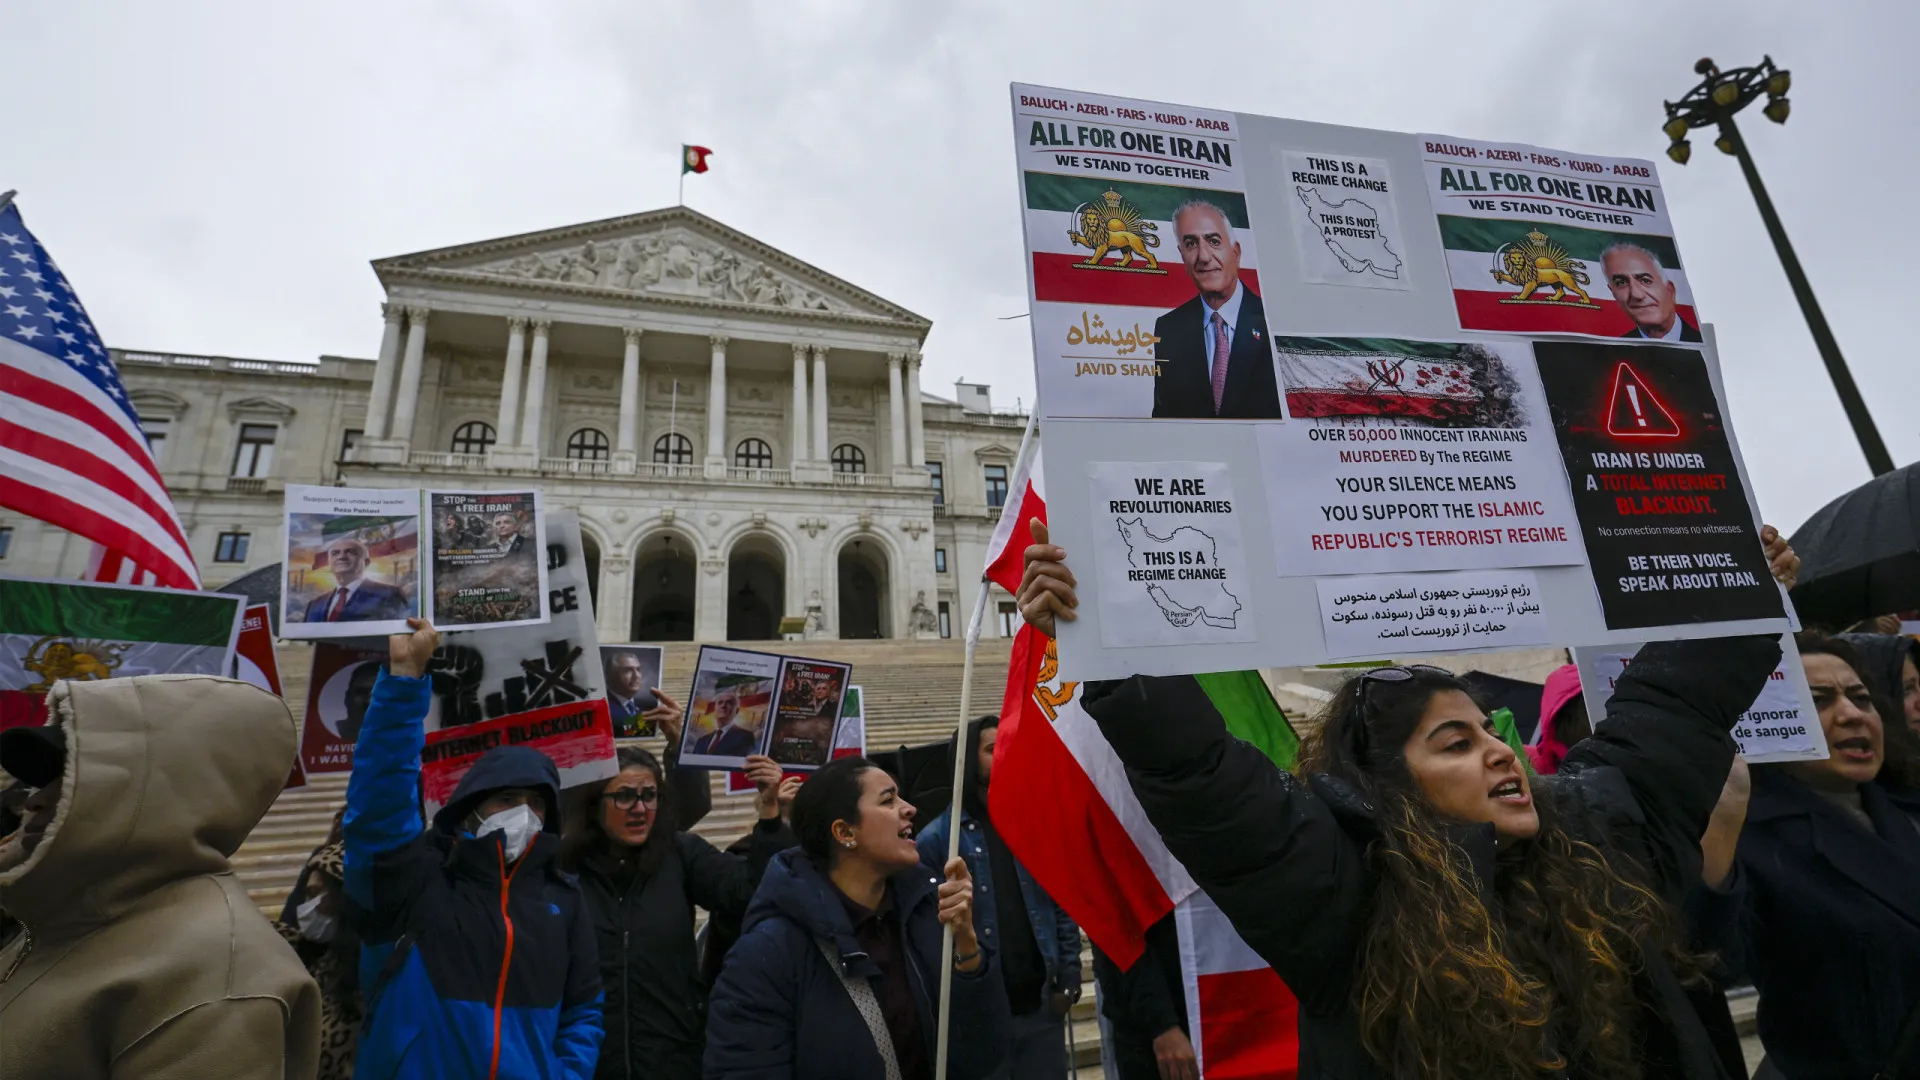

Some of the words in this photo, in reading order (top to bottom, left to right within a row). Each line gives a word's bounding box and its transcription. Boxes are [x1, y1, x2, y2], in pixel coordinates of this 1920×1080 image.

[1020, 95, 1068, 111] BALUCH
[1076, 102, 1108, 117] AZERI
[1116, 107, 1146, 122] FARS
[1154, 112, 1187, 126] KURD
[1195, 117, 1229, 132] ARAB
[1029, 121, 1073, 147] ALL
[1077, 125, 1115, 149] FOR
[1120, 130, 1165, 155] ONE
[1169, 136, 1231, 167] IRAN
[1055, 154, 1079, 168] WE
[1082, 156, 1131, 174] STAND
[1135, 162, 1210, 181] TOGETHER
[1306, 157, 1338, 174] THIS
[1341, 160, 1354, 174] IS
[1358, 162, 1369, 176] A
[1425, 142, 1476, 158] BALUCH
[1486, 148, 1522, 163] AZERI
[1530, 153, 1560, 168] FARS
[1568, 159, 1603, 173] KURD
[1613, 164, 1650, 178] ARAB
[1291, 171, 1339, 189] REGIME
[1341, 176, 1388, 193] CHANGE
[1440, 167, 1487, 192] ALL
[1491, 172, 1534, 194] FOR
[1537, 176, 1582, 200] ONE
[1586, 183, 1656, 212] IRAN
[1319, 213, 1341, 225] THIS
[1342, 215, 1353, 227] IS
[1355, 216, 1377, 229] NOT
[1468, 199, 1497, 212] WE
[1500, 201, 1553, 218] STAND
[1556, 206, 1634, 226] TOGETHER
[1324, 225, 1332, 237] A
[1333, 226, 1376, 240] PROTEST
[1075, 362, 1117, 377] JAVID
[1121, 364, 1162, 377] SHAH
[1309, 429, 1346, 441] OVER
[1349, 429, 1397, 444] 50,000
[1400, 429, 1464, 442] INNOCENT
[1467, 429, 1527, 442] IRANIANS
[1339, 450, 1417, 463] MURDERED
[1419, 451, 1435, 465] By
[1436, 451, 1460, 463] The
[1463, 450, 1512, 463] REGIME
[1592, 452, 1633, 468] IRAN
[1636, 453, 1651, 468] IS
[1654, 453, 1705, 469] UNDER
[1134, 479, 1165, 496] WE
[1169, 478, 1206, 496] ARE
[1336, 477, 1385, 493] YOUR
[1389, 476, 1456, 492] SILENCE
[1458, 476, 1516, 491] MEANS
[1586, 474, 1598, 491] A
[1600, 474, 1651, 491] TOTAL
[1653, 474, 1726, 490] INTERNET
[443, 496, 466, 504] STOP
[463, 504, 485, 512] FREE
[486, 504, 512, 512] IRAN!
[1109, 500, 1232, 515] REVOLUTIONARIES
[1616, 496, 1717, 516] BLACKOUT.
[1321, 505, 1358, 522] YOU
[1362, 503, 1441, 521] SUPPORT
[1442, 503, 1475, 518] THE
[1478, 501, 1544, 518] ISLAMIC
[1311, 532, 1413, 551] REPUBLIC'S
[1416, 529, 1502, 547] TERRORIST
[1508, 527, 1567, 543] REGIME
[1599, 527, 1612, 536] No
[1614, 525, 1662, 536] connection
[1662, 526, 1689, 535] means
[1702, 525, 1744, 534] witnesses.
[1143, 551, 1175, 566] THIS
[1178, 552, 1192, 565] IS
[1195, 551, 1206, 565] A
[1628, 556, 1649, 571] BE
[1650, 555, 1692, 570] THEIR
[1693, 553, 1738, 568] VOICE.
[1128, 569, 1175, 582] REGIME
[1178, 568, 1226, 581] CHANGE
[1618, 575, 1670, 593] SPEAK
[1673, 573, 1719, 590] ABOUT
[1720, 572, 1759, 588] IRAN.
[458, 588, 485, 597] STAND
[1748, 708, 1799, 724] ignorar
[508, 709, 594, 743] BLACKOUT
[1735, 726, 1753, 738] de
[1756, 724, 1806, 739] sangue
[320, 754, 348, 764] WAS
